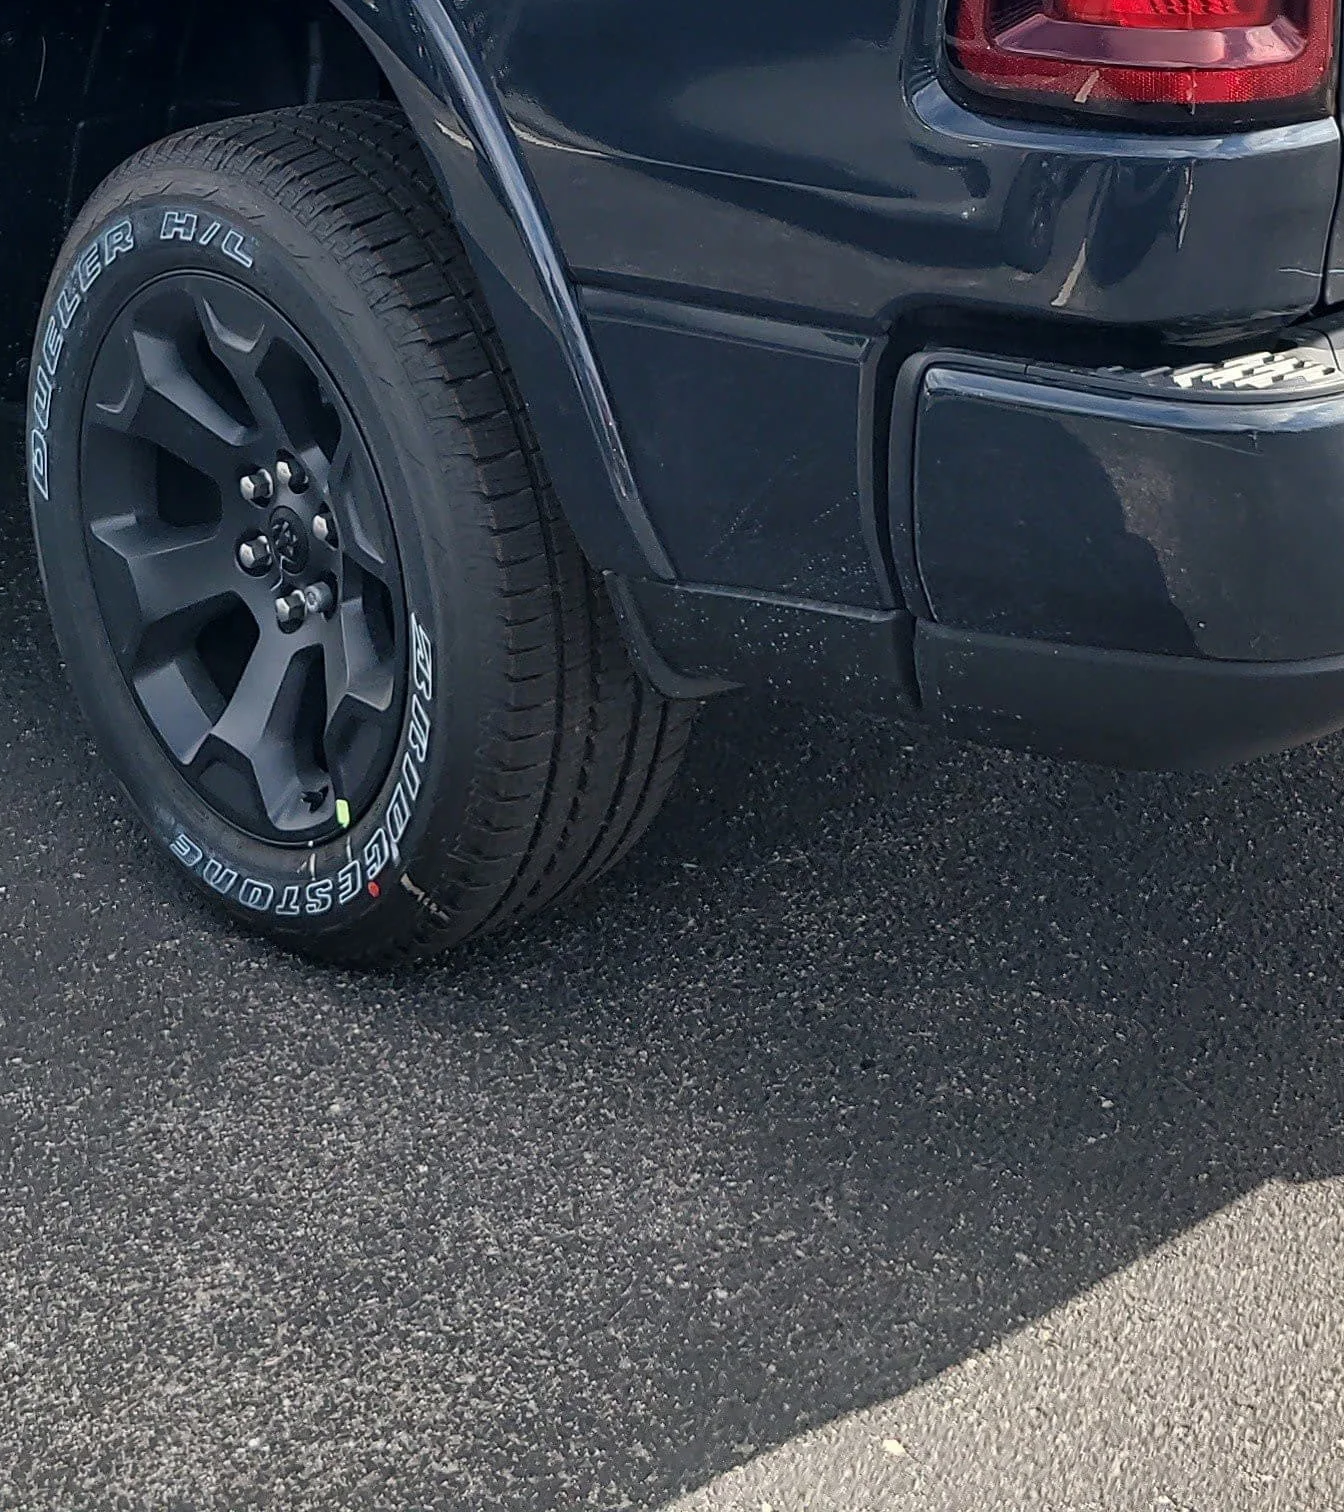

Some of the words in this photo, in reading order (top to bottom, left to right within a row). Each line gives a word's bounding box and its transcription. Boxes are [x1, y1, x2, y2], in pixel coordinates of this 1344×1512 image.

[32, 220, 134, 501] DUELER
[159, 211, 253, 268] H/L
[168, 611, 433, 916] BRIDGESTONE
